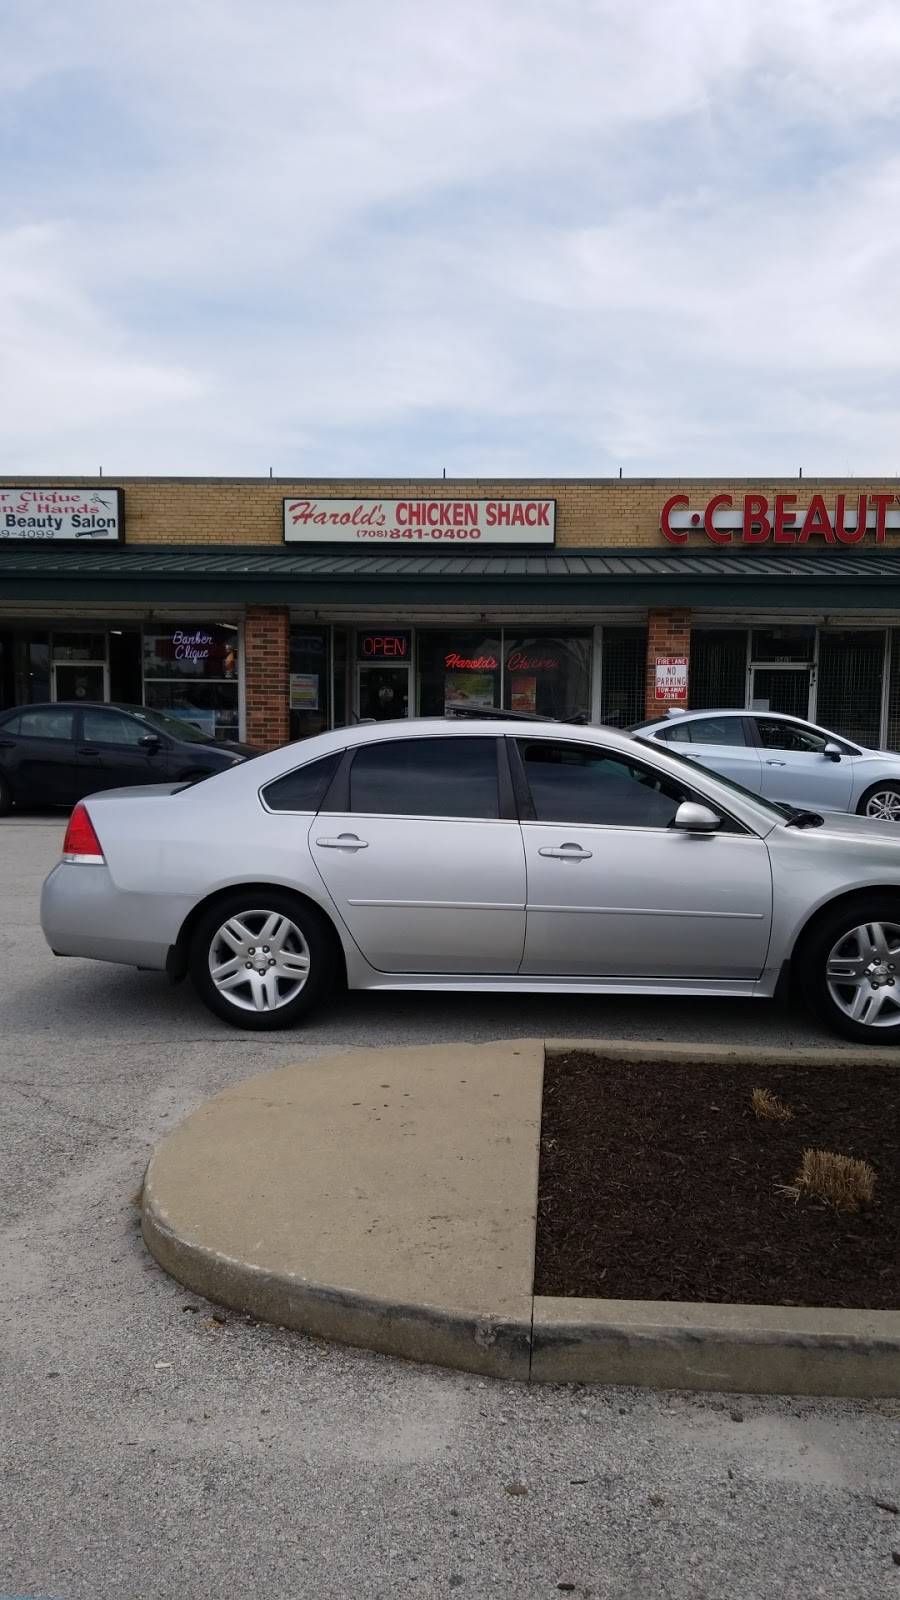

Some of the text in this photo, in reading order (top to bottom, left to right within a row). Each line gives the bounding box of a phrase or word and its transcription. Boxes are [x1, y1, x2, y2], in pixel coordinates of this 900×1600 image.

[20, 491, 80, 503] Clique
[37, 503, 100, 514] Hands
[288, 501, 551, 526] Harold's CHICKEN SHACK
[6, 514, 116, 530] Beauty Salon
[743, 494, 900, 544] BEAUT
[0, 530, 54, 538] 9-4099
[173, 631, 213, 645] Barber
[363, 637, 406, 656] OPEN
[175, 645, 209, 664] Clique
[666, 666, 677, 676] NO
[657, 677, 686, 686] PARKING
